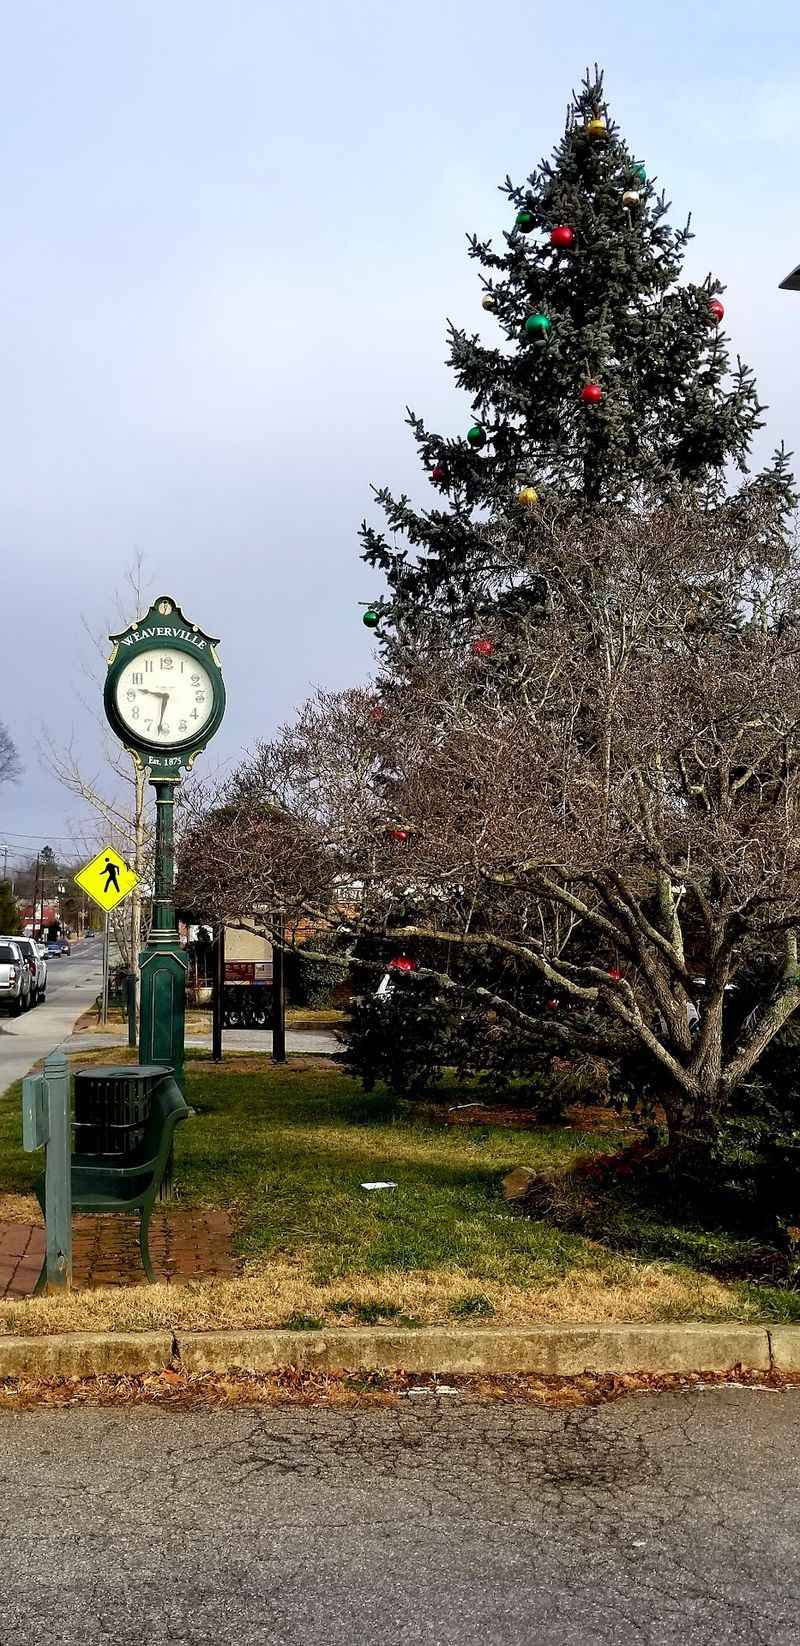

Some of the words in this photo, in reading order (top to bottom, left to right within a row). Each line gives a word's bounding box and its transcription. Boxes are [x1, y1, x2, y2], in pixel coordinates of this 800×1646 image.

[121, 627, 207, 650] WEAVERVILLE
[145, 660, 153, 673] 11
[160, 657, 174, 670] 12
[190, 673, 200, 687] 2
[126, 689, 136, 702] 9
[195, 689, 205, 703] 3
[131, 707, 140, 720] 8
[189, 707, 199, 720] 4
[144, 718, 153, 732] 7
[164, 756, 182, 767] 1875
